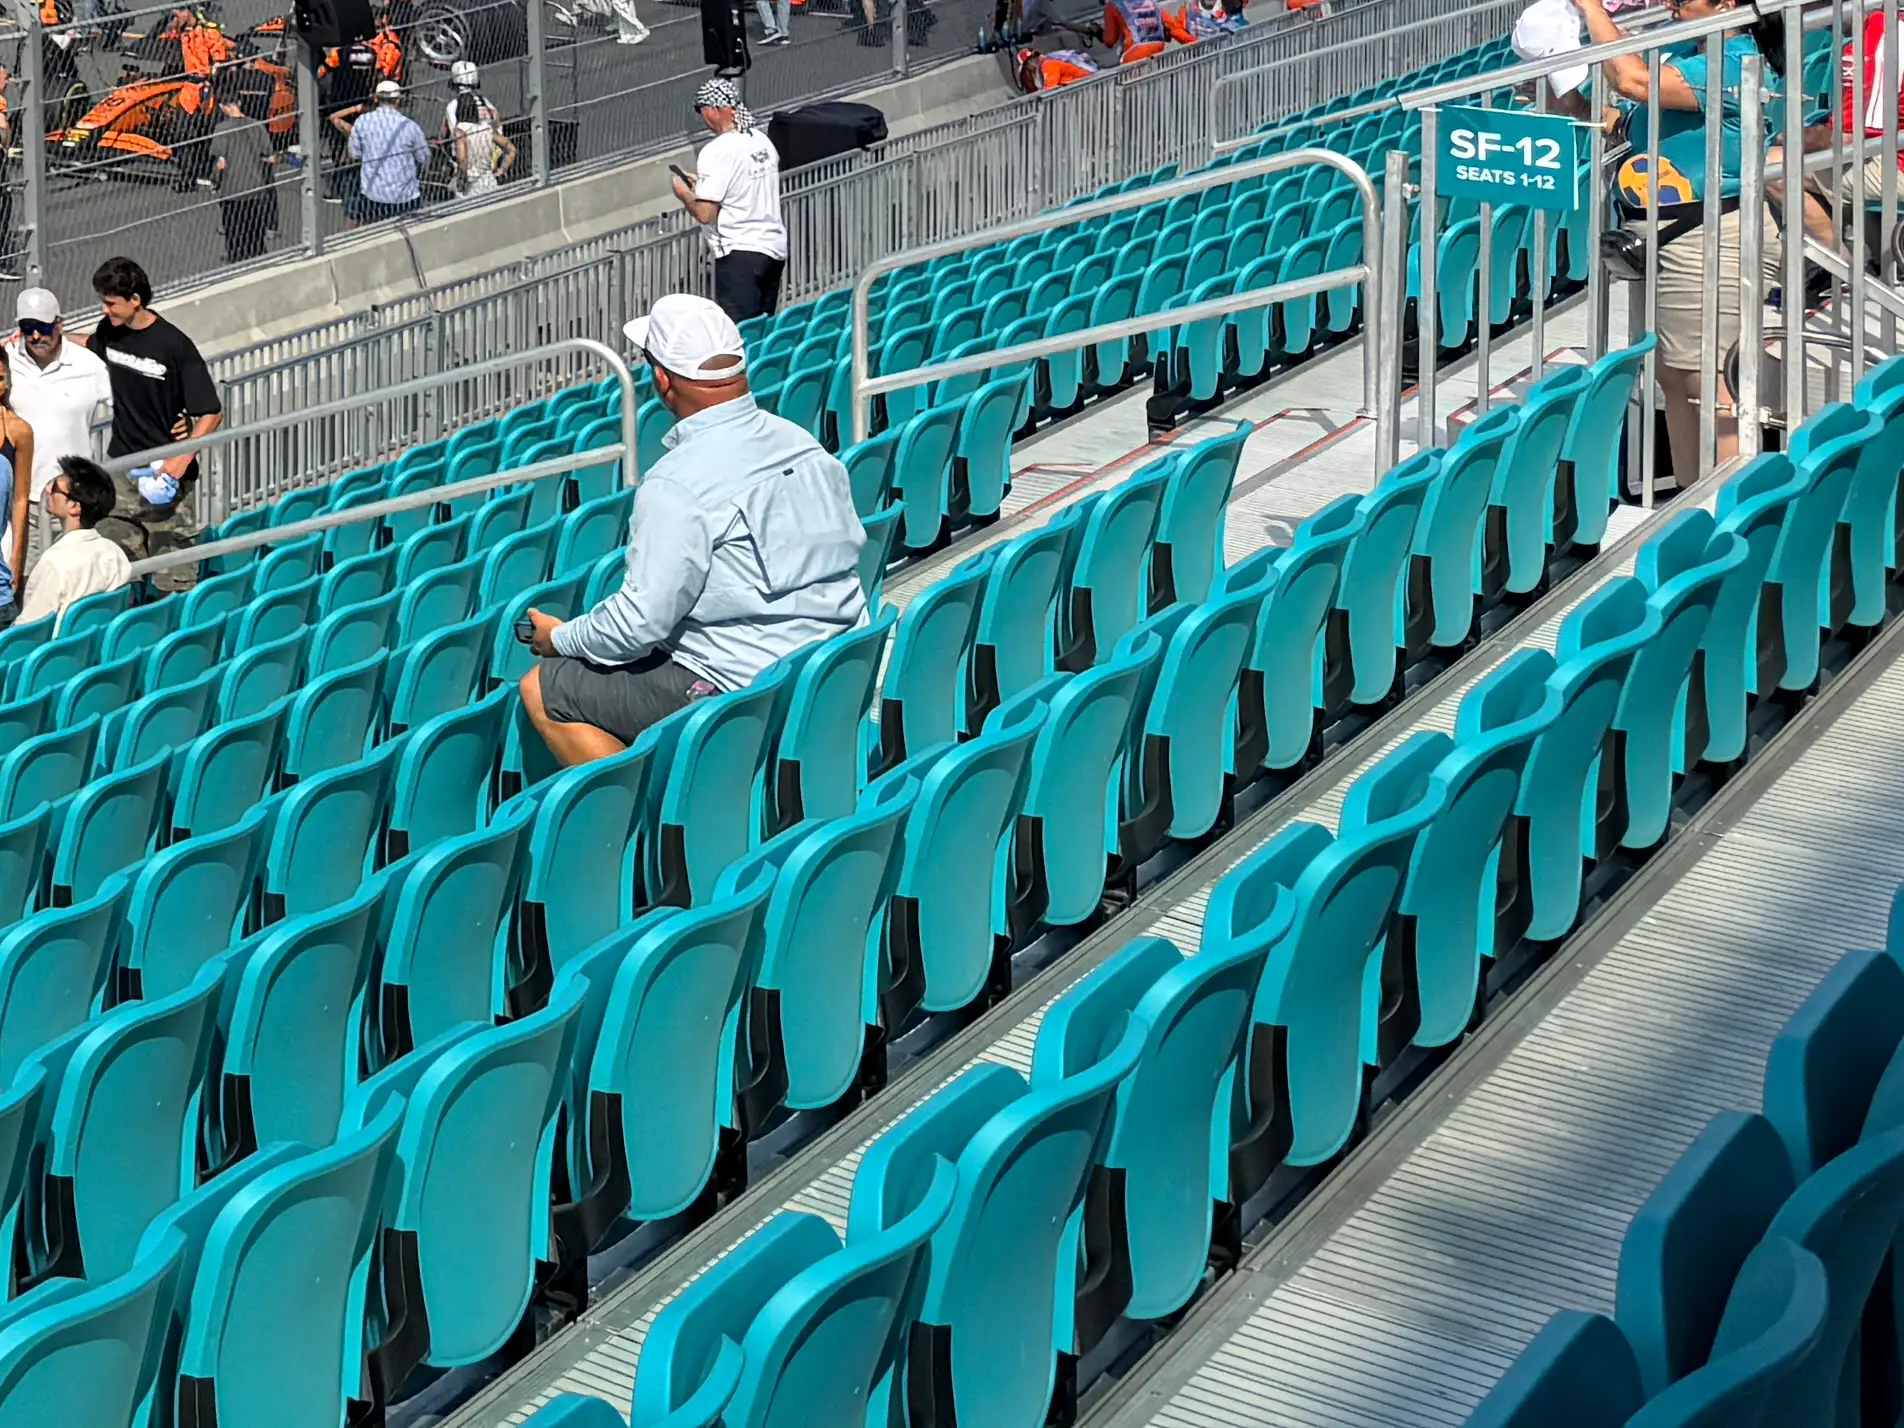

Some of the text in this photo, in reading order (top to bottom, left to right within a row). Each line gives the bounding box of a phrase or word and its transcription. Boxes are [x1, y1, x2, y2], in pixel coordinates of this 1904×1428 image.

[1449, 127, 1562, 170] SF-12
[1455, 164, 1556, 191] SEATS 1-12
